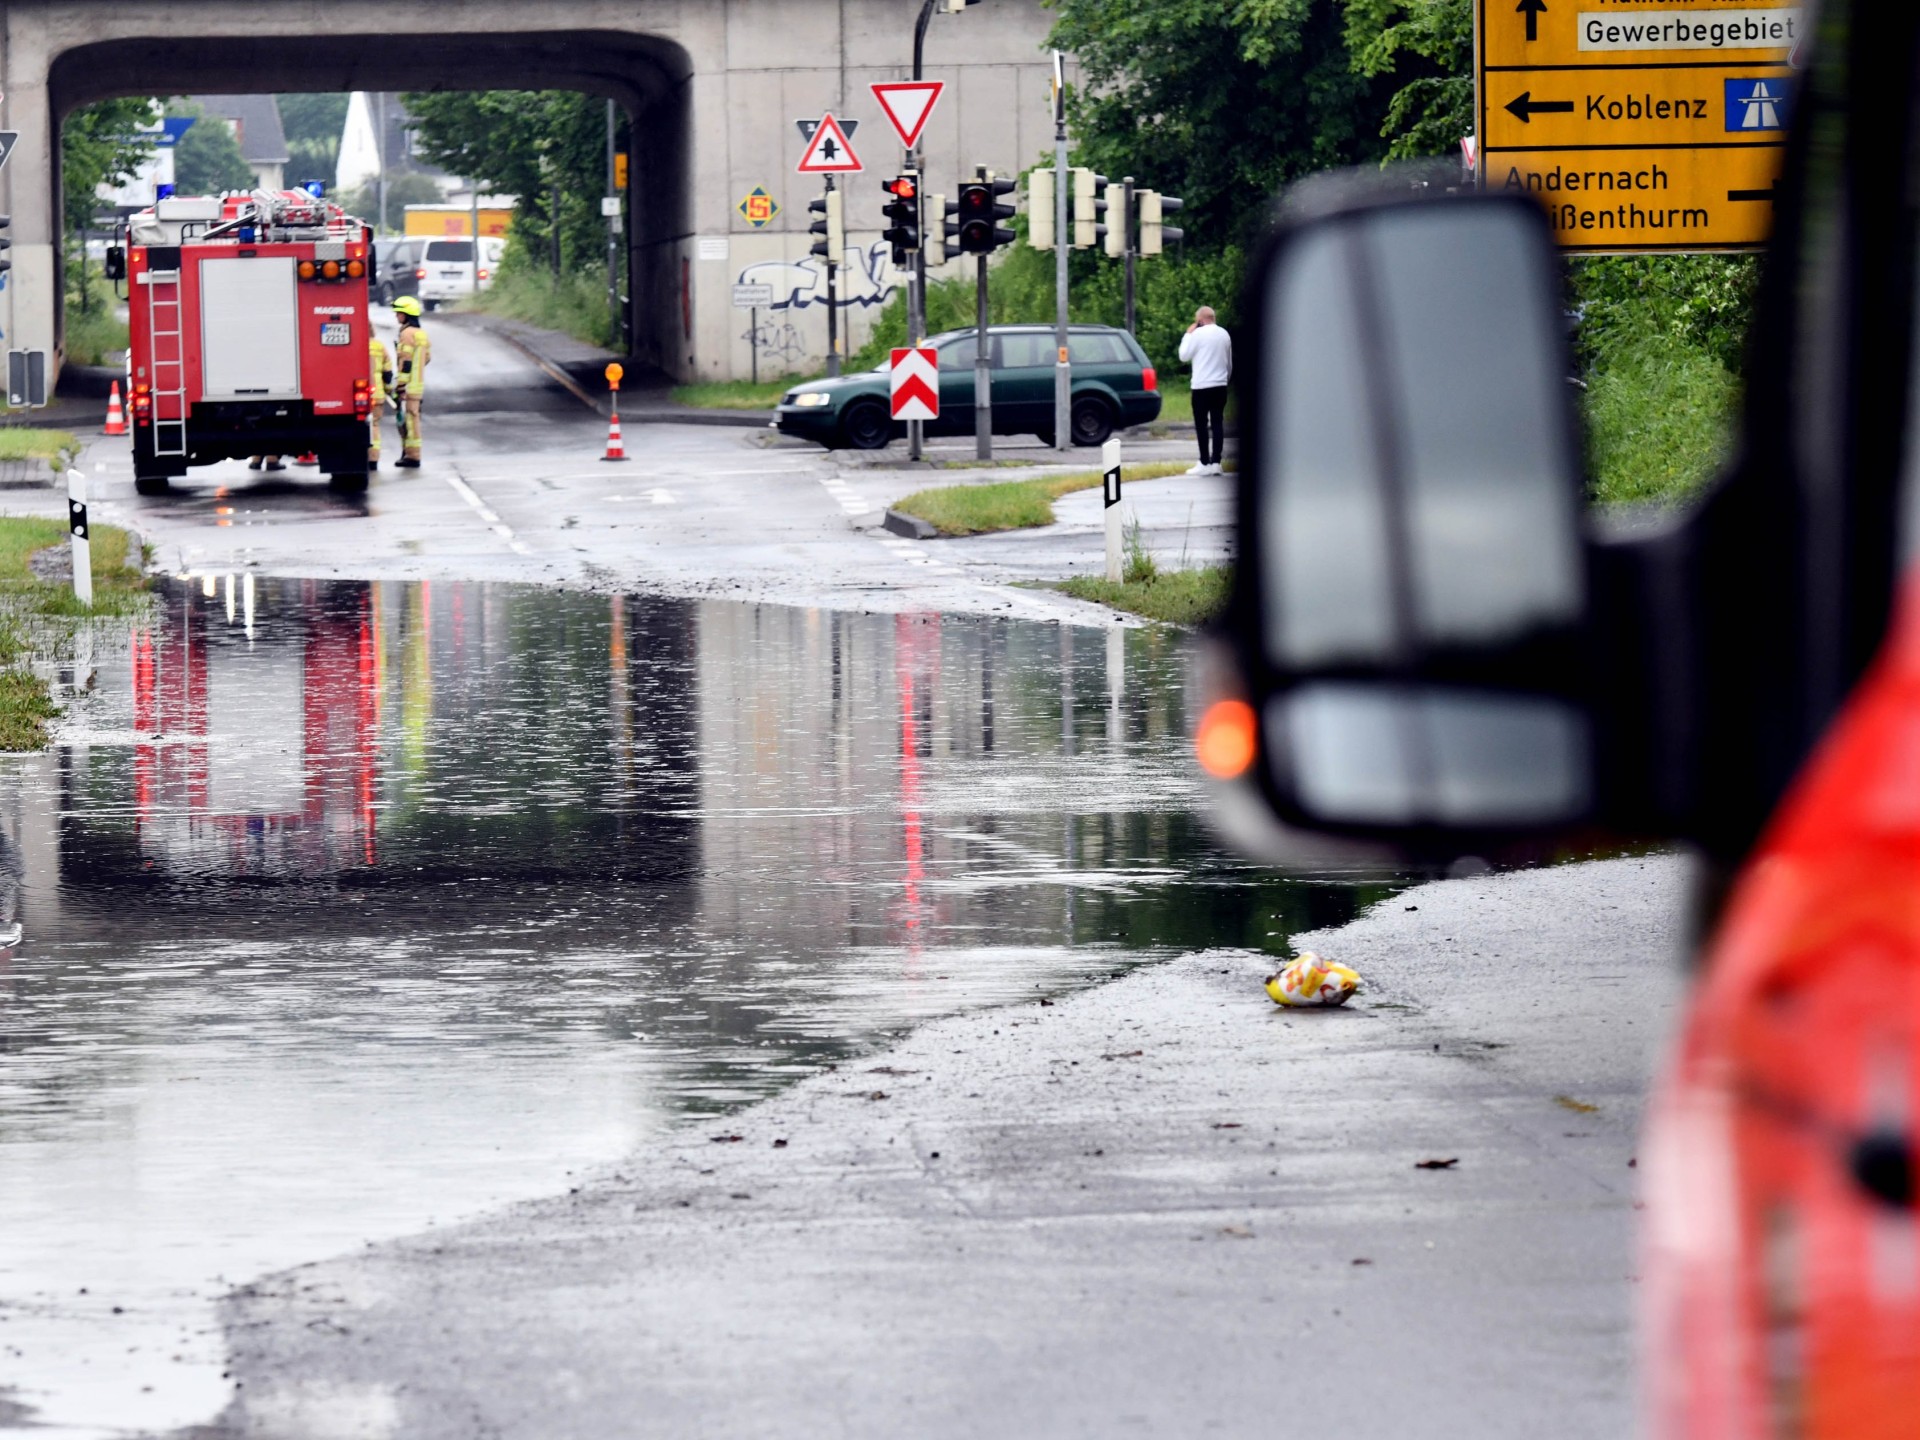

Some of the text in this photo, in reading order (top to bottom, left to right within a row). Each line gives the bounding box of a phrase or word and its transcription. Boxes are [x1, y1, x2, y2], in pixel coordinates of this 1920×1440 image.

[1586, 17, 1794, 46] Gewerbegebiet
[1586, 93, 1707, 120] Koblenz
[1504, 164, 1668, 192] Andernach
[1551, 203, 1709, 231] ißenthurm
[313, 306, 355, 315] MAGIRUS
